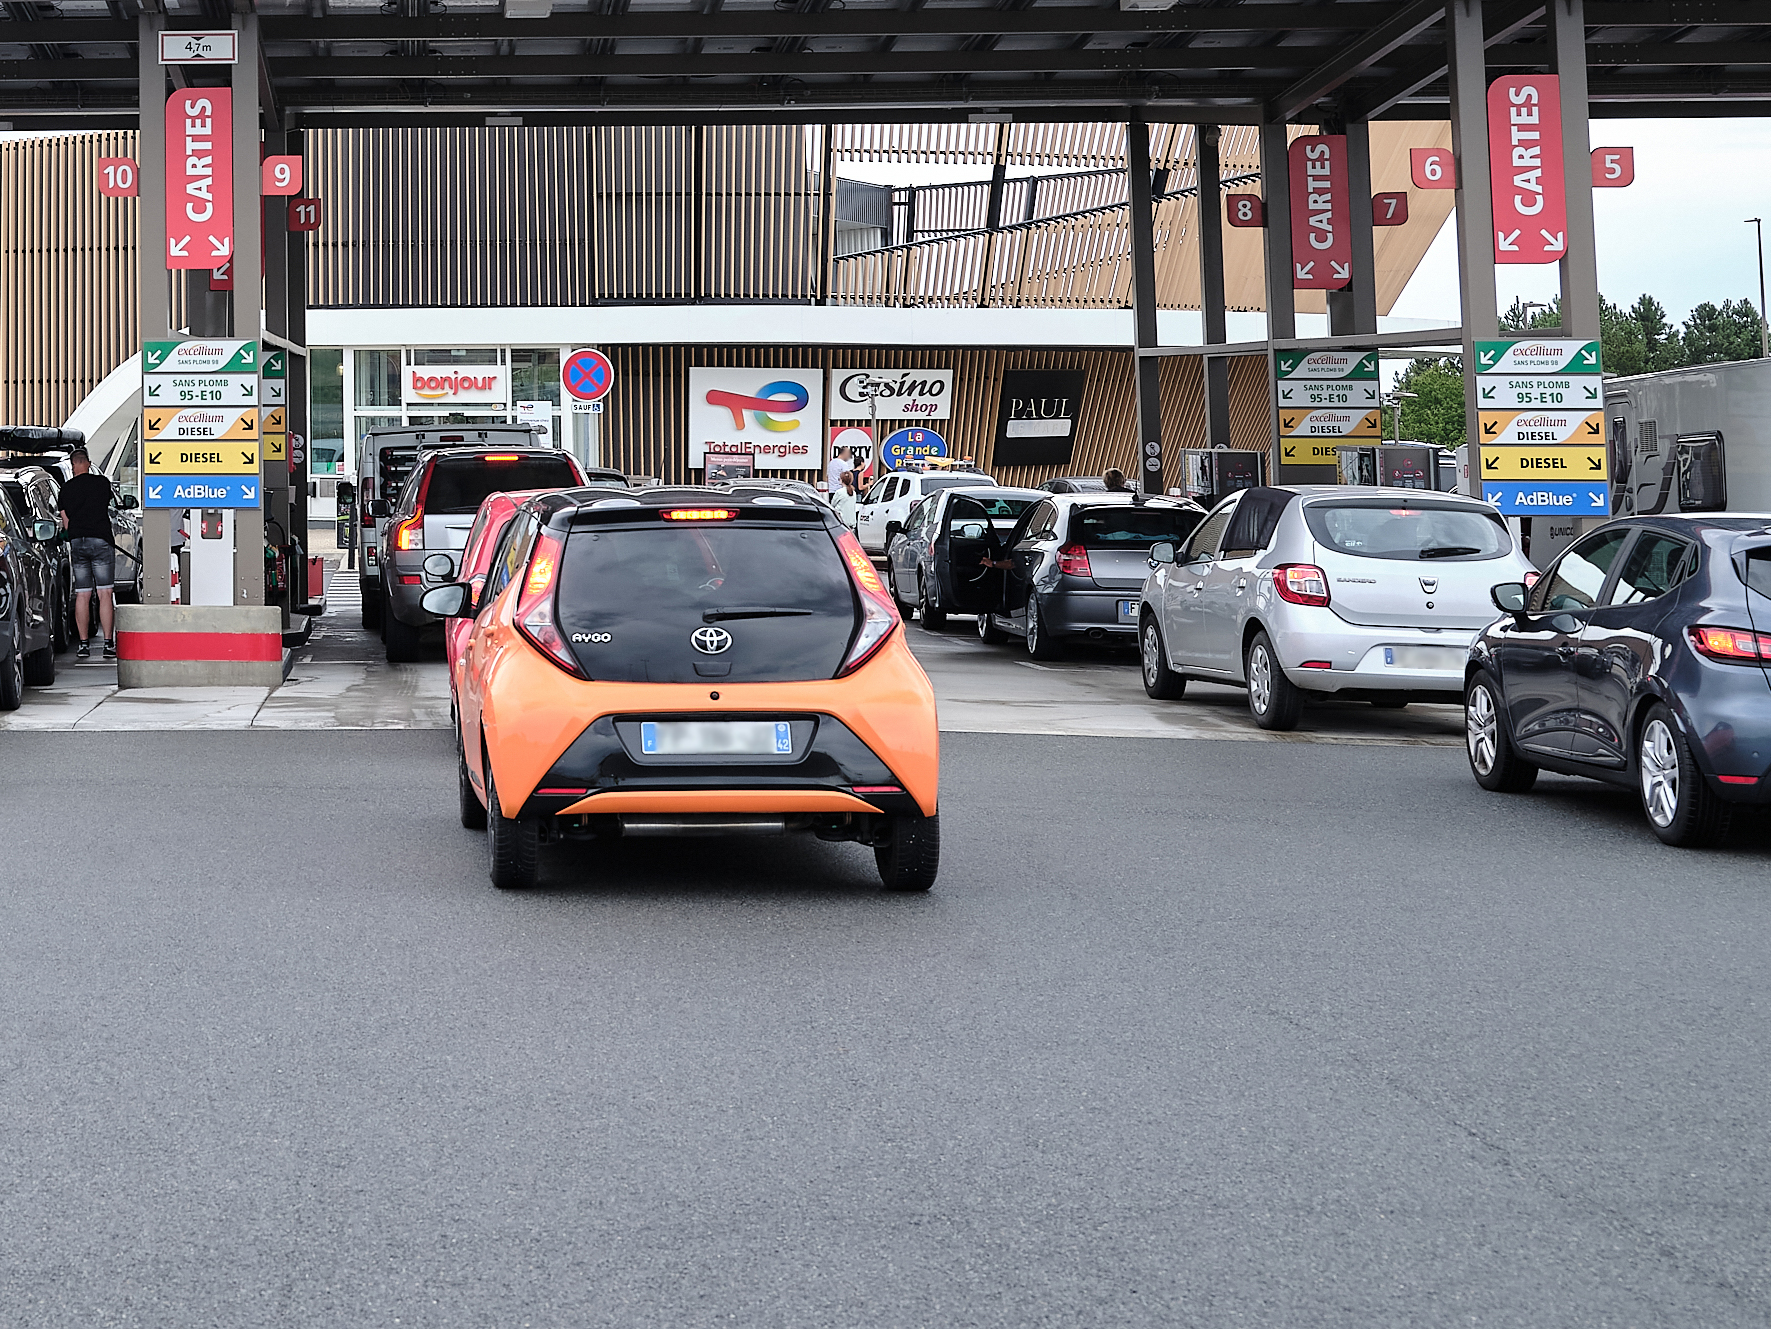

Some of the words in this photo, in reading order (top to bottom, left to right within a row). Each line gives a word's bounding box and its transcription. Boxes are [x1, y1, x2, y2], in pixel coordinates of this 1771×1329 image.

[1509, 84, 1544, 217] CARTES
[185, 98, 213, 223] CARTES
[1424, 156, 1442, 182] 6
[1605, 155, 1622, 179] 5
[103, 165, 133, 189] 10
[274, 163, 291, 188] 9
[1307, 142, 1333, 251] CARTES
[295, 205, 316, 224] 11
[1236, 199, 1253, 221] 8
[1383, 199, 1398, 219] 7
[177, 345, 224, 356] excellium
[1512, 346, 1563, 356] excellium
[1307, 356, 1348, 365] excellium
[172, 379, 196, 387] SANS
[198, 379, 229, 387] PLOMB
[412, 371, 498, 395] bonjour
[839, 372, 945, 403] Csino
[1508, 381, 1534, 389] SANS
[1536, 381, 1570, 389] PLOMB
[179, 390, 222, 401] 95-E10
[1310, 393, 1348, 403] 95-E10
[1517, 392, 1563, 403] 95-E10
[902, 399, 938, 416] shop
[1009, 398, 1073, 419] PAUL
[177, 412, 224, 423] excellium
[1309, 414, 1350, 422] excellium
[1516, 417, 1567, 427] excellium
[178, 427, 215, 436] DIESEL
[1310, 425, 1343, 433] DIESEL
[908, 431, 924, 442] La
[1517, 431, 1557, 440] DIESEL
[704, 441, 808, 457] TotalEnergies
[833, 445, 871, 459] DRTY
[891, 445, 939, 455] Grande
[1312, 446, 1336, 456] DIES
[180, 453, 223, 463] DIESEL
[1520, 457, 1567, 468] DIESEL
[173, 484, 227, 499] AdBlue
[1514, 491, 1573, 506] AdBlue
[571, 632, 612, 643] AYGO
[777, 739, 789, 750] 42
